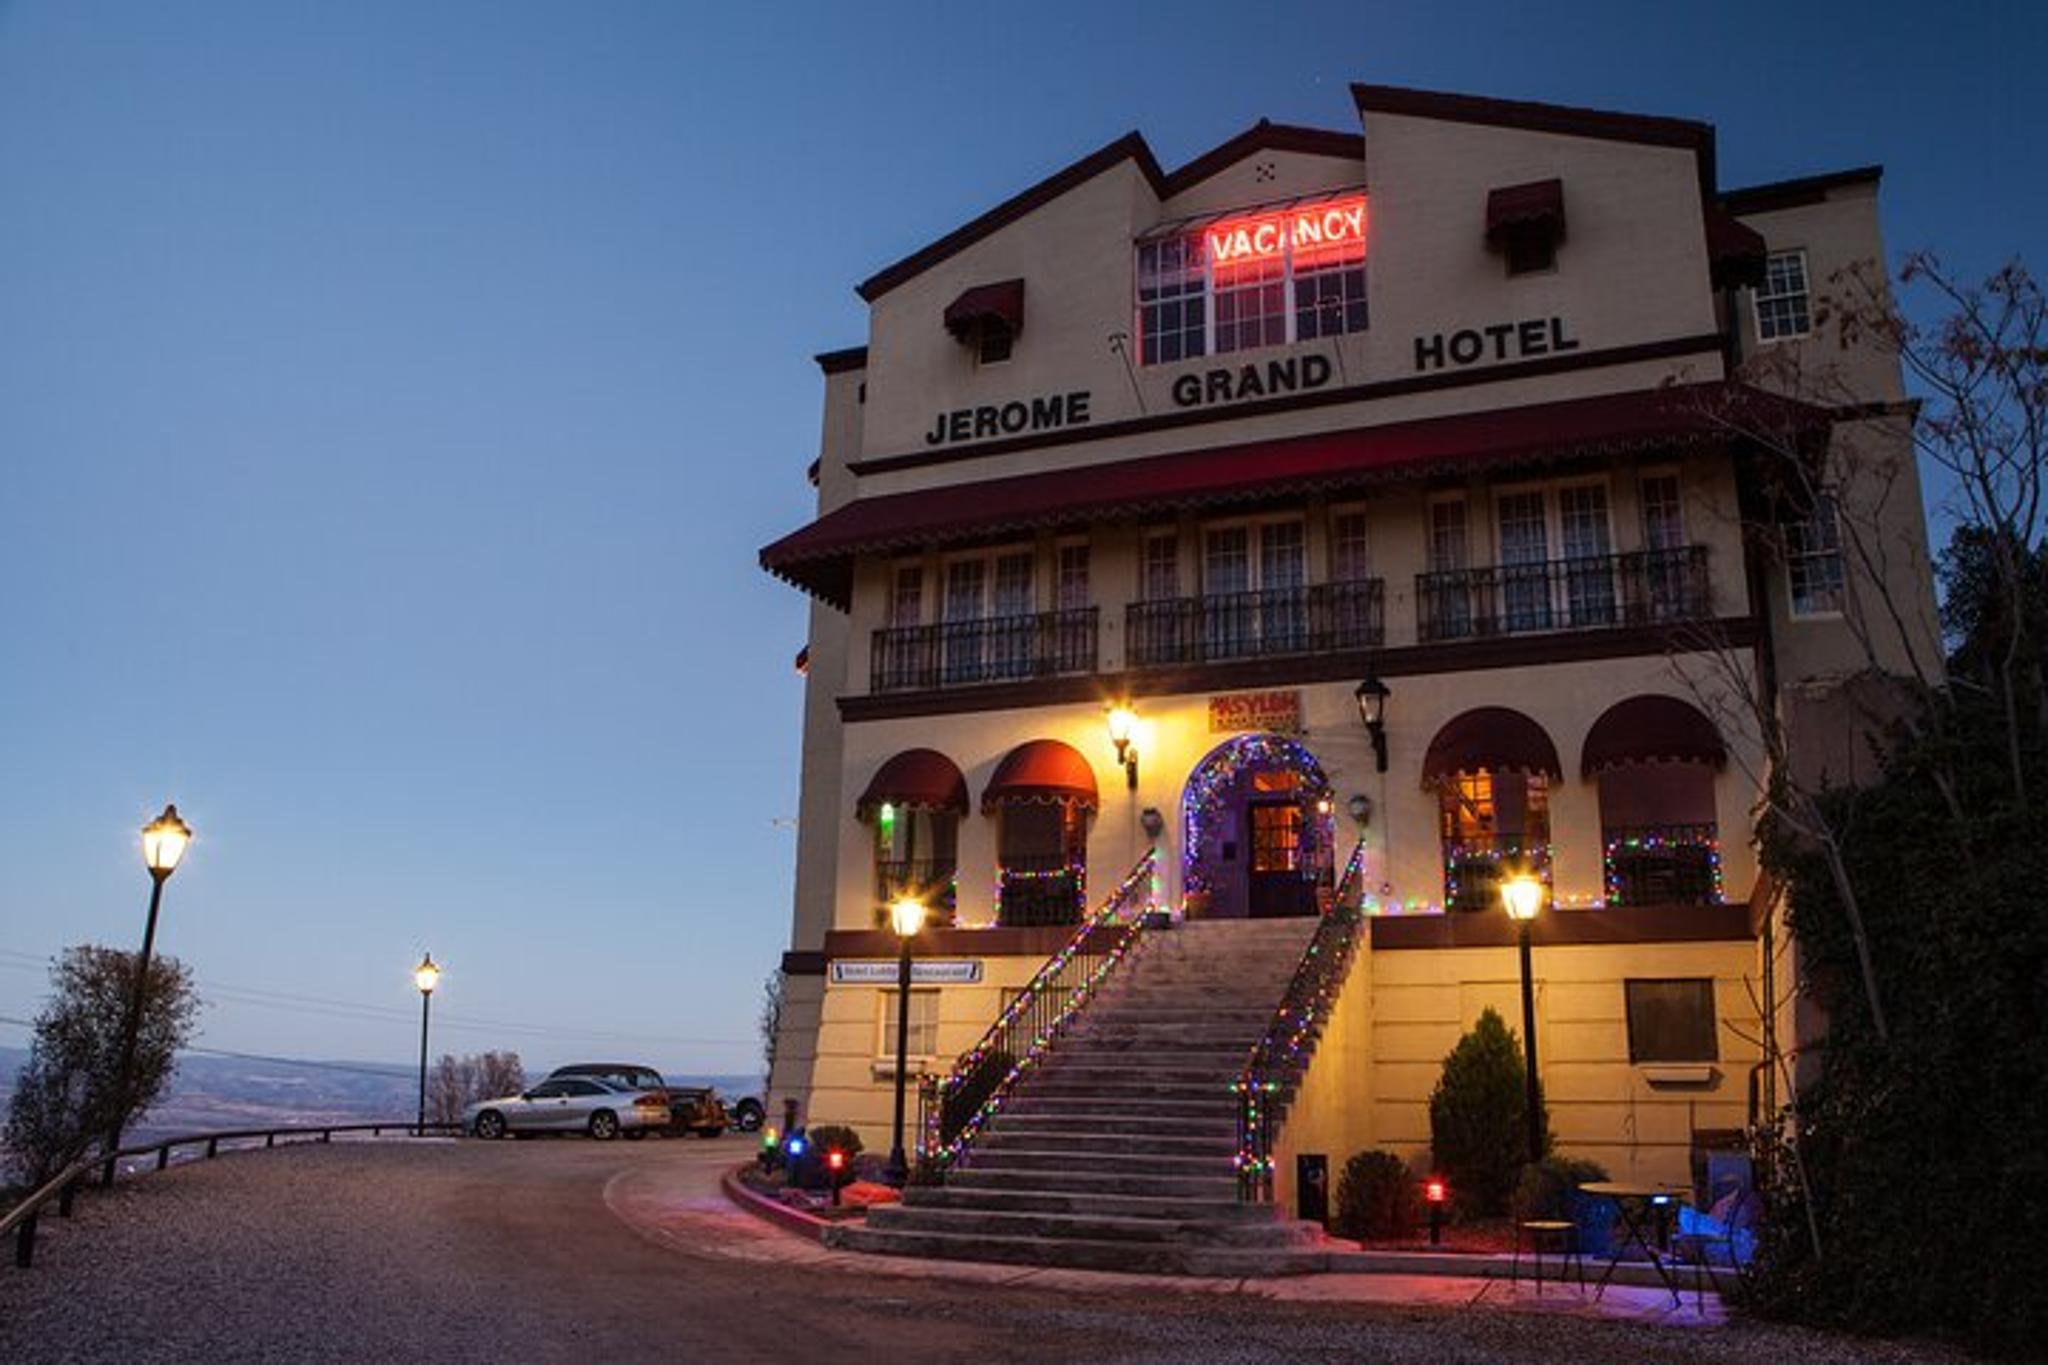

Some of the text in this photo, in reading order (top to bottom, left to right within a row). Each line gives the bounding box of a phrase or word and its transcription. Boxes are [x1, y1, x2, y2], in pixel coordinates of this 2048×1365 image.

[1211, 205, 1365, 262] VACANCY
[925, 317, 1581, 446] JEROME GRAND HOTEL
